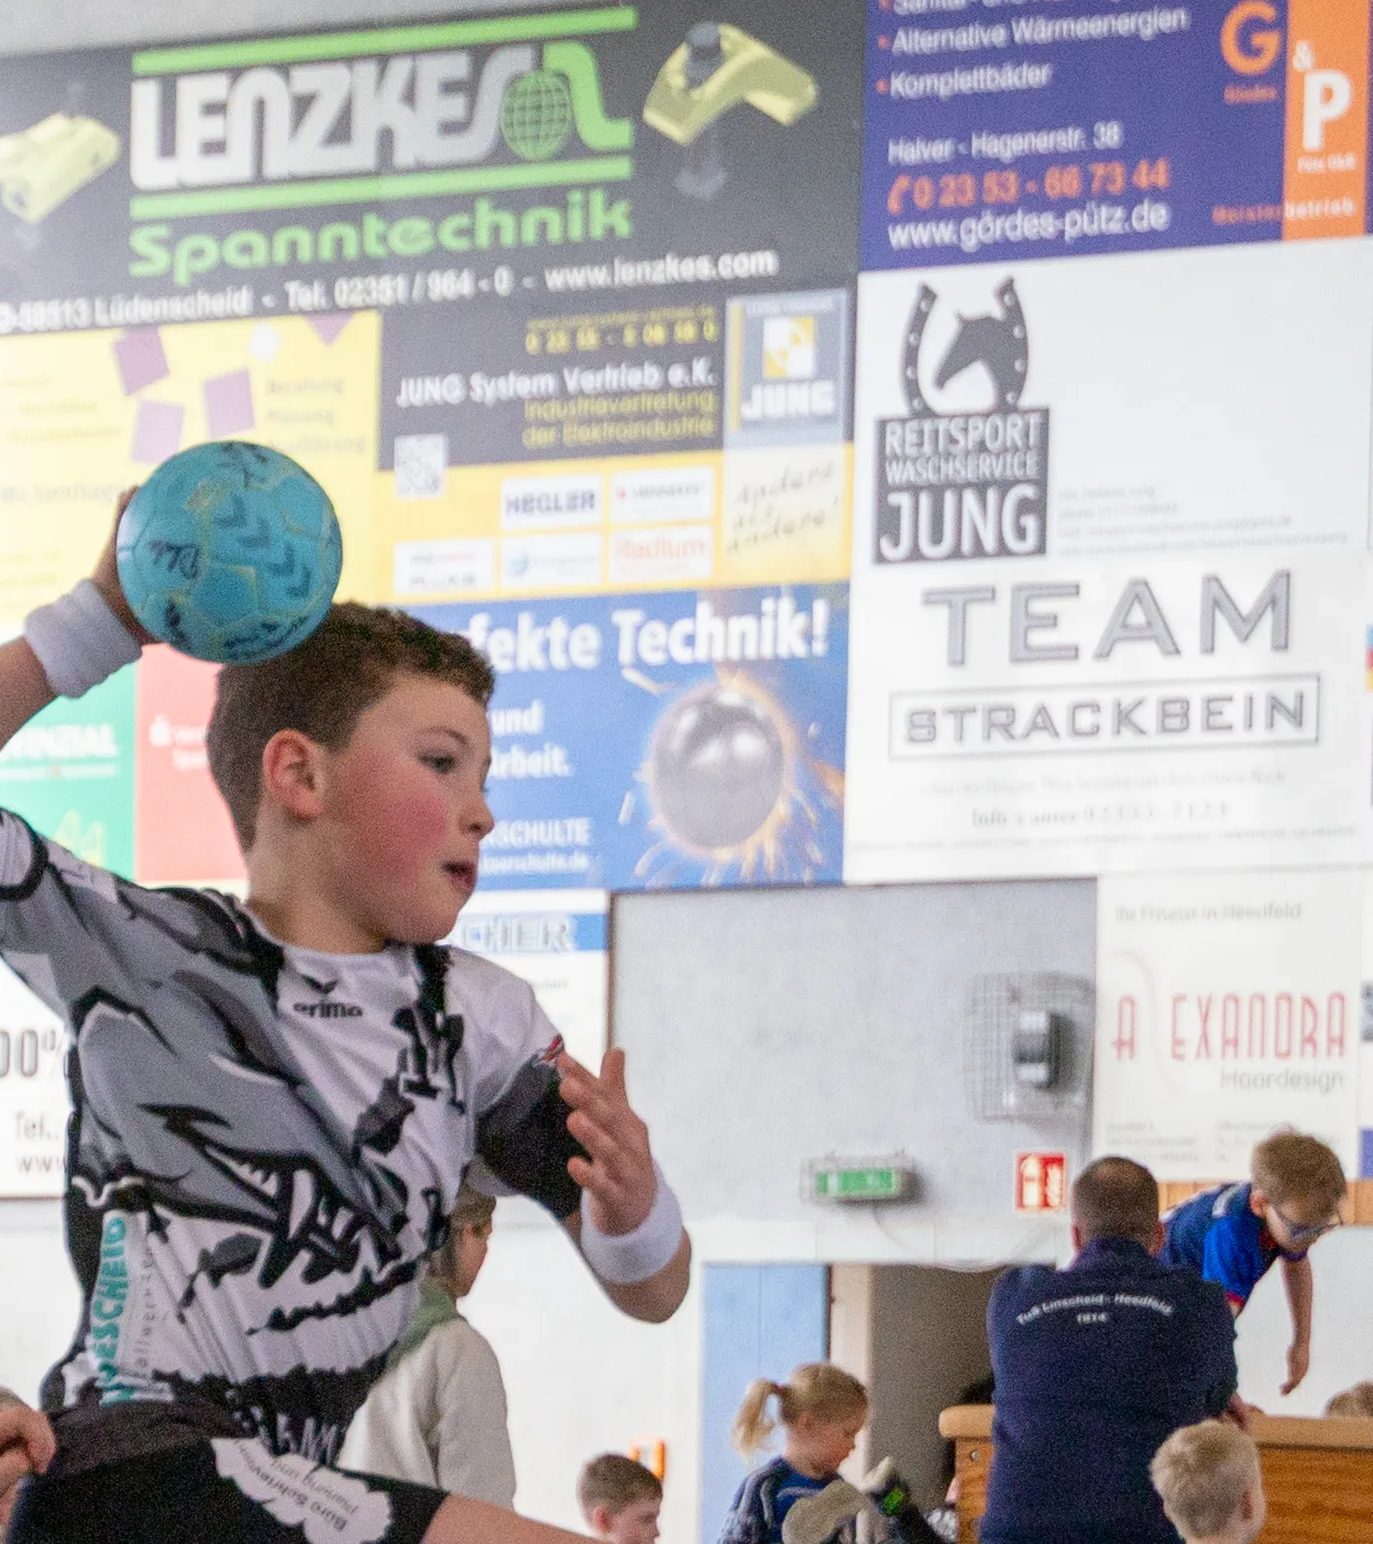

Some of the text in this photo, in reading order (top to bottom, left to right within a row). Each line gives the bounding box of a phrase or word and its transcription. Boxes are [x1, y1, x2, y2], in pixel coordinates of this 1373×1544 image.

[892, 20, 1007, 54] Alternative
[1011, 7, 1191, 44] Wärmeenergien
[890, 61, 1053, 101] Komplettbäder
[1302, 69, 1352, 151] P
[888, 136, 954, 165] Halver
[129, 188, 633, 286] Spanntechnik
[887, 198, 1172, 253] www.gördes-pütz.de
[95, 286, 251, 325] Lüdenscheid
[545, 249, 779, 293] www.lenzkes.com
[397, 372, 466, 408] JUNG
[470, 368, 557, 405] System
[562, 359, 662, 394] Vertrieb
[741, 380, 835, 421] JUNG
[884, 416, 1040, 456] REITSPORT
[885, 455, 1039, 485] WASCHSERVICE
[879, 483, 1036, 562] JUNG
[612, 594, 831, 665] Technik!
[921, 569, 1292, 667] TEAM
[906, 691, 1305, 745] STRACKBEIN
[293, 1000, 364, 1020] erima
